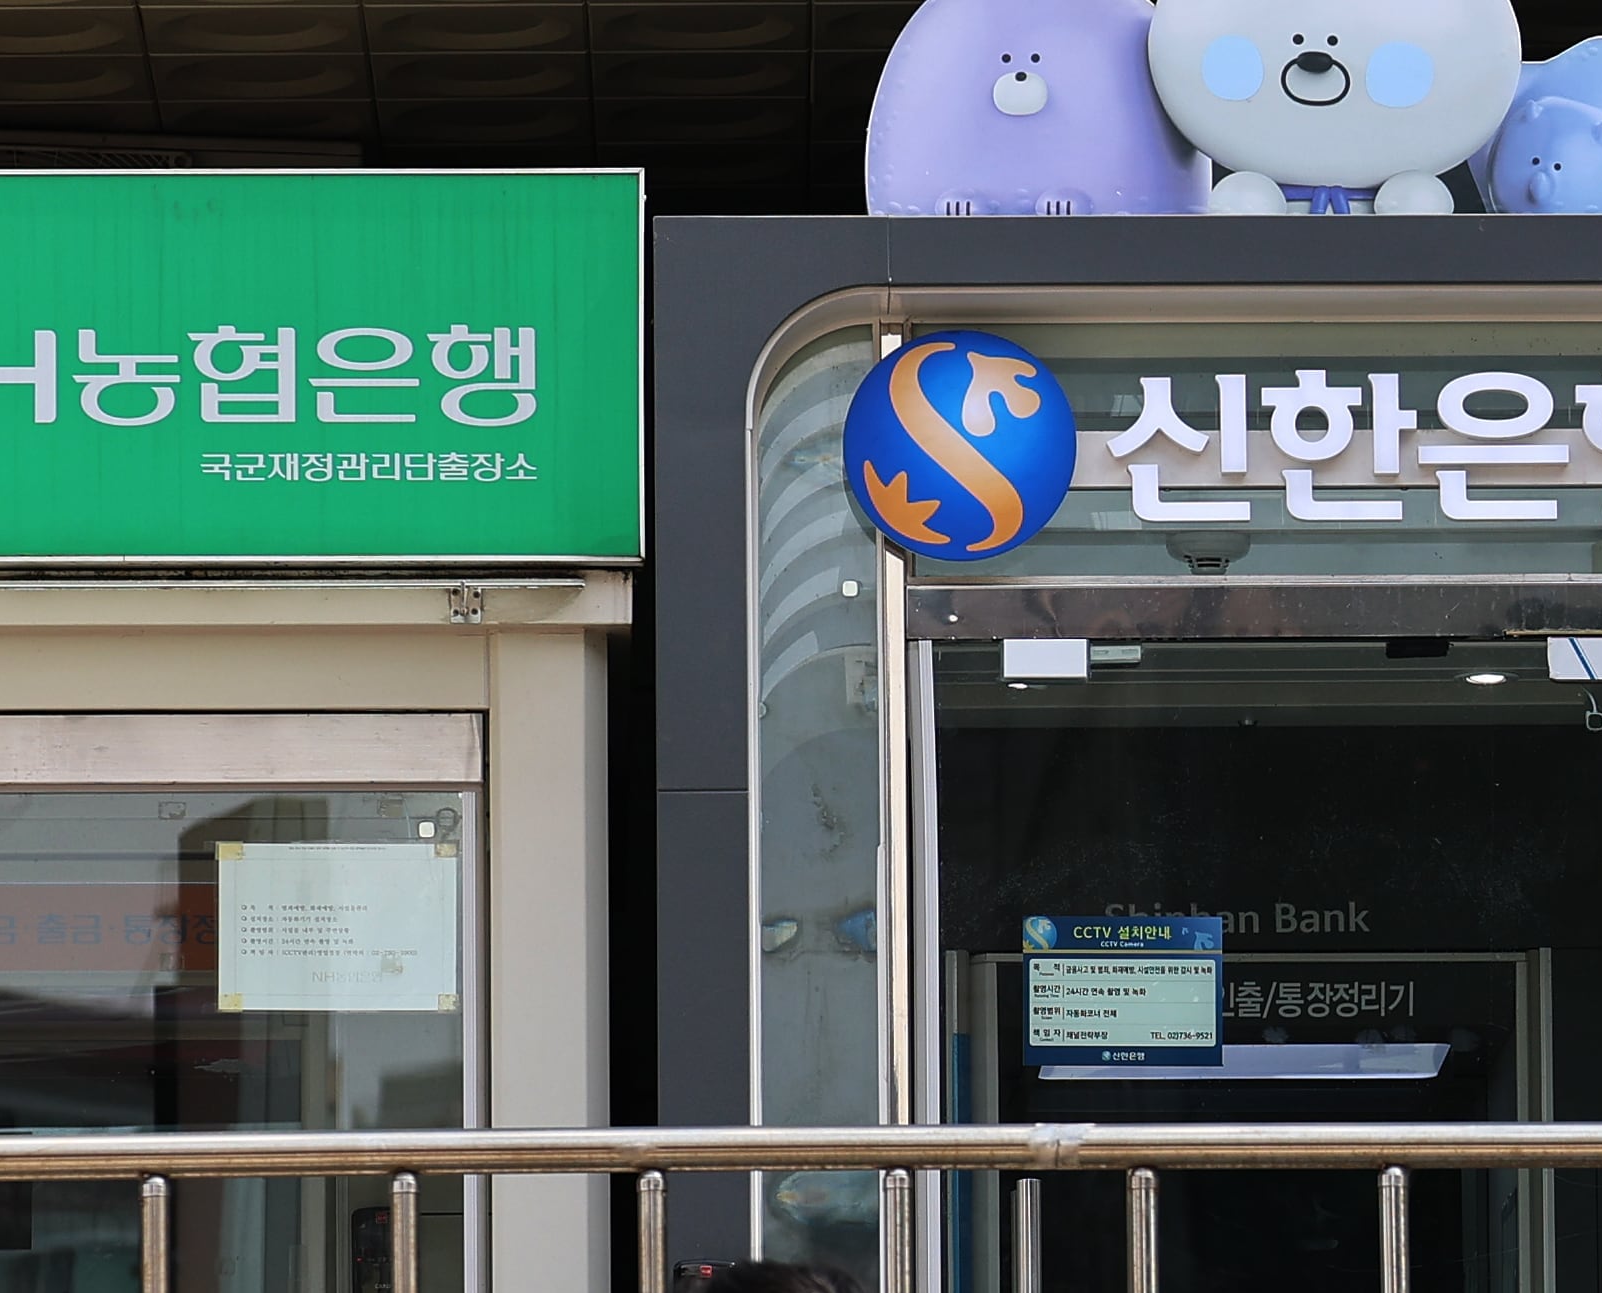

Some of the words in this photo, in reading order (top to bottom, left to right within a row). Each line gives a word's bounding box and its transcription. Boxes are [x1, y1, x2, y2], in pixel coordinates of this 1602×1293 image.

[200, 451, 538, 482] 국군재정관리단출장소
[1074, 926, 1111, 938] CCTV
[1117, 926, 1172, 940] 설치안내
[1275, 902, 1371, 934] Bank
